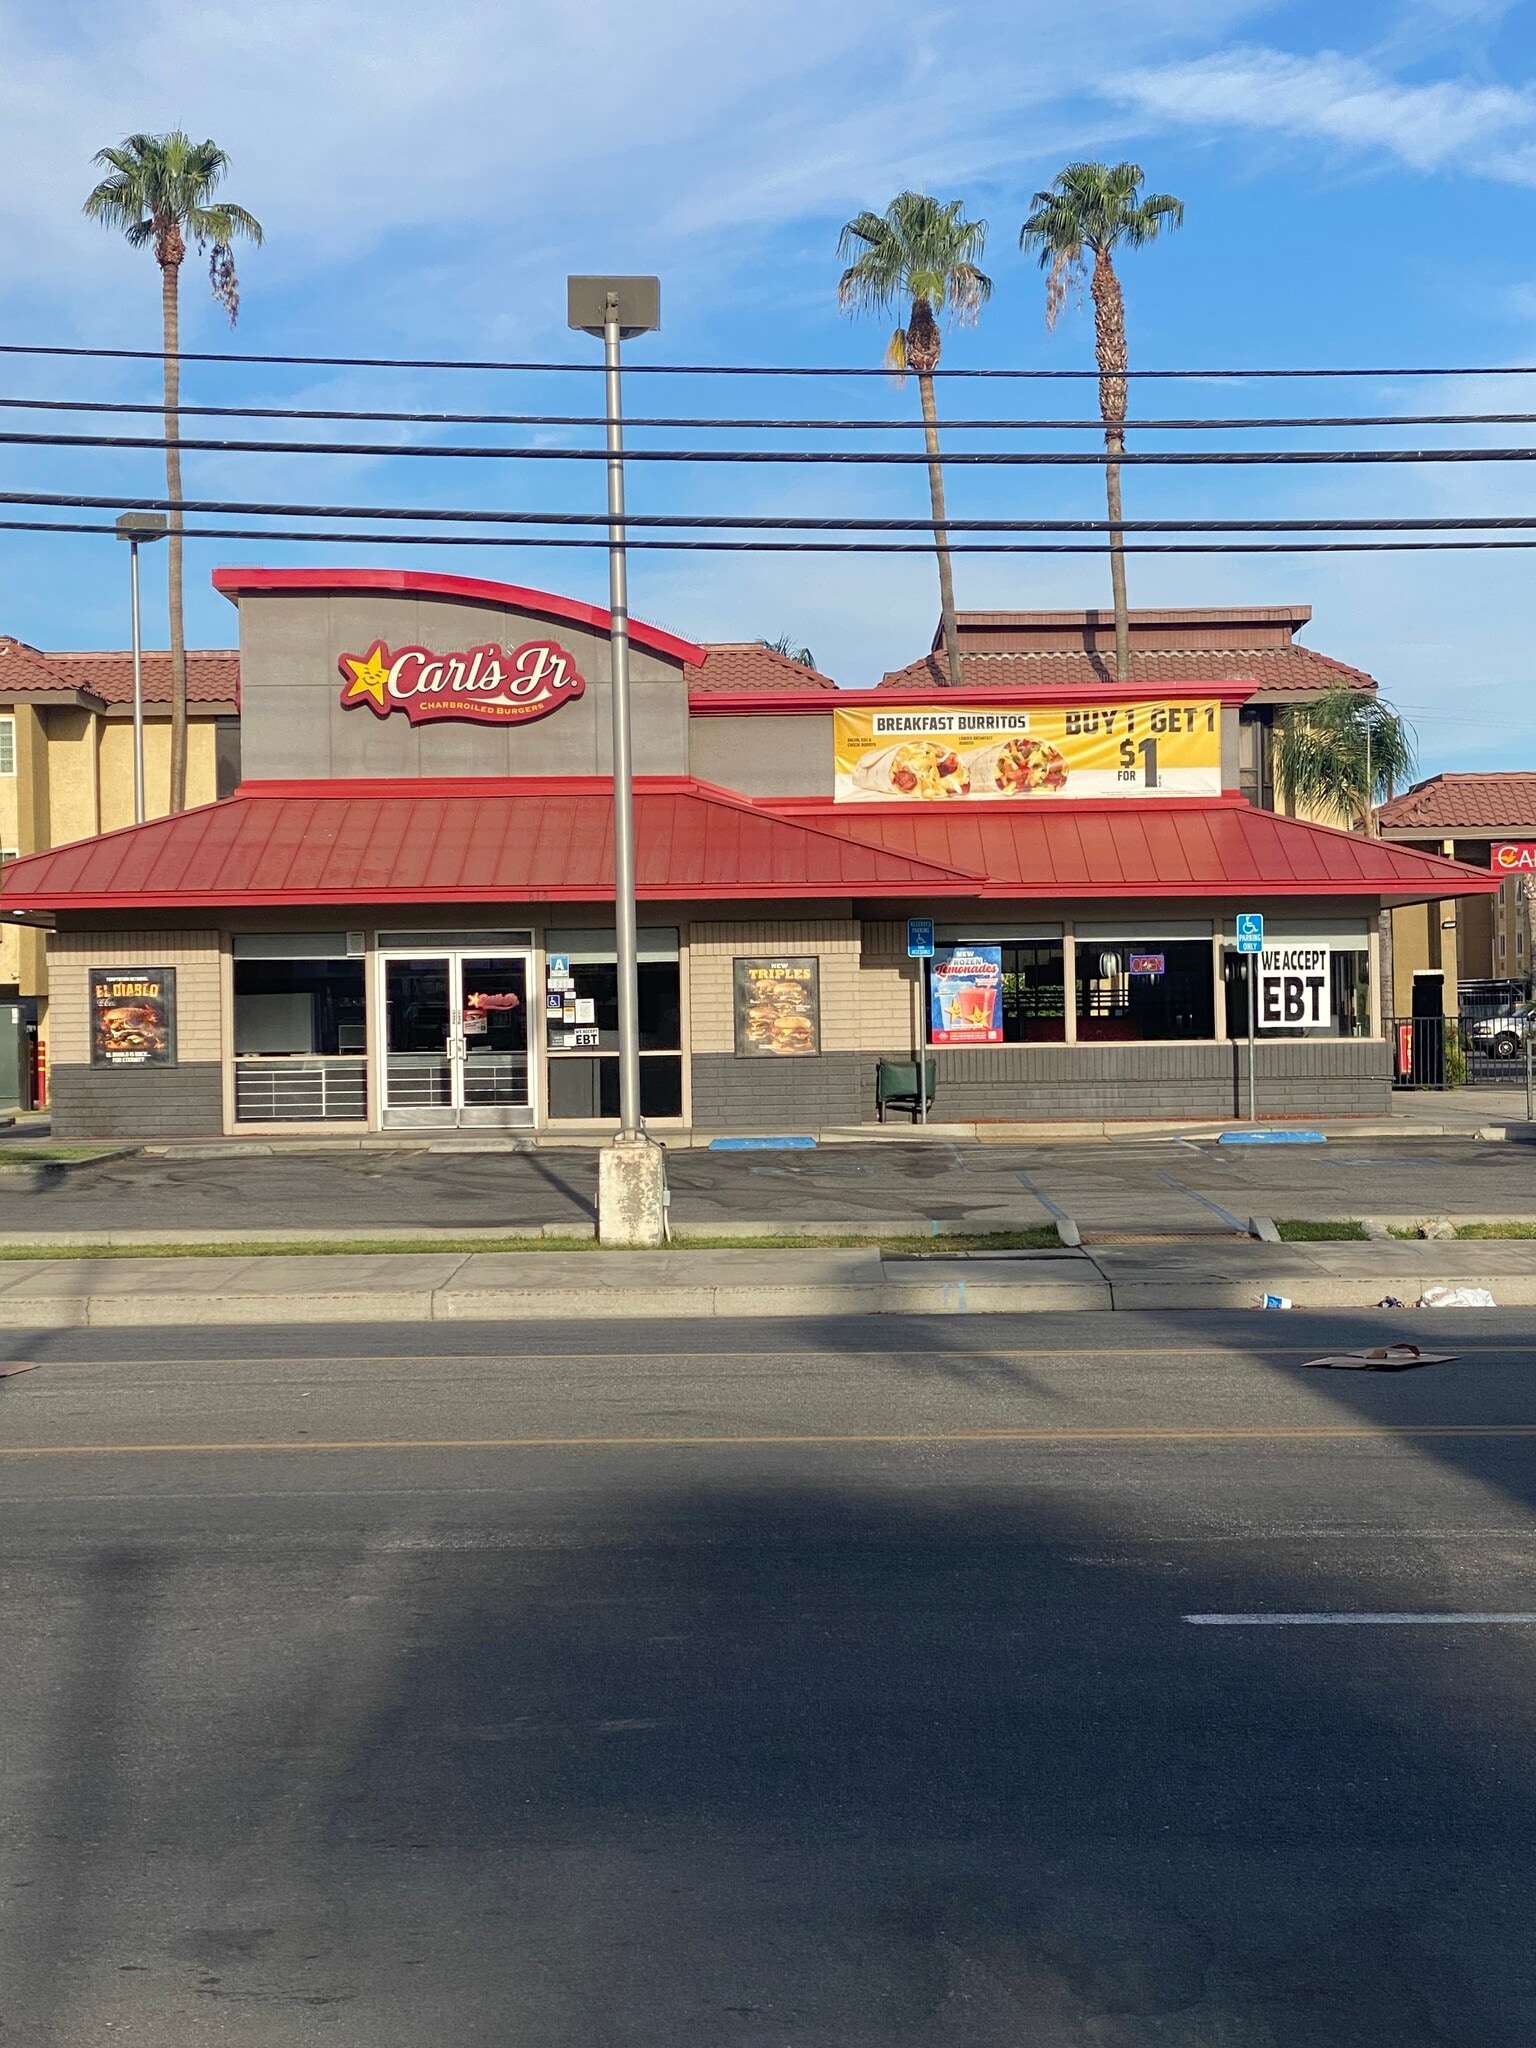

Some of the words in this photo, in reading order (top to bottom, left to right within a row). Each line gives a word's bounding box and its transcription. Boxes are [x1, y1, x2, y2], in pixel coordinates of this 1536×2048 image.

[387, 648, 508, 699] Carl's
[419, 701, 495, 714] CHARBROILED
[496, 702, 545, 715] BURGERS
[876, 716, 954, 731] BREAKFAST
[958, 715, 1027, 730] BURRITOS
[1065, 710, 1118, 736] BUY
[1125, 709, 1135, 733] 1
[1150, 708, 1198, 733] GET
[1205, 707, 1215, 732] 1
[1117, 770, 1136, 781] FOR
[1497, 846, 1536, 869] CA
[1239, 934, 1261, 942] PARKING
[1243, 942, 1257, 950] ONLY
[554, 959, 565, 970] A
[1133, 957, 1163, 972] OPEN
[1262, 950, 1280, 970] WE
[1282, 950, 1326, 970] ACCEPT
[748, 969, 811, 979] TRIPLES
[934, 963, 997, 977] Lemonades
[95, 984, 111, 998] EL
[112, 983, 159, 997] DIABLO
[1263, 976, 1325, 1021] EBT
[575, 1034, 598, 1045] EBT
